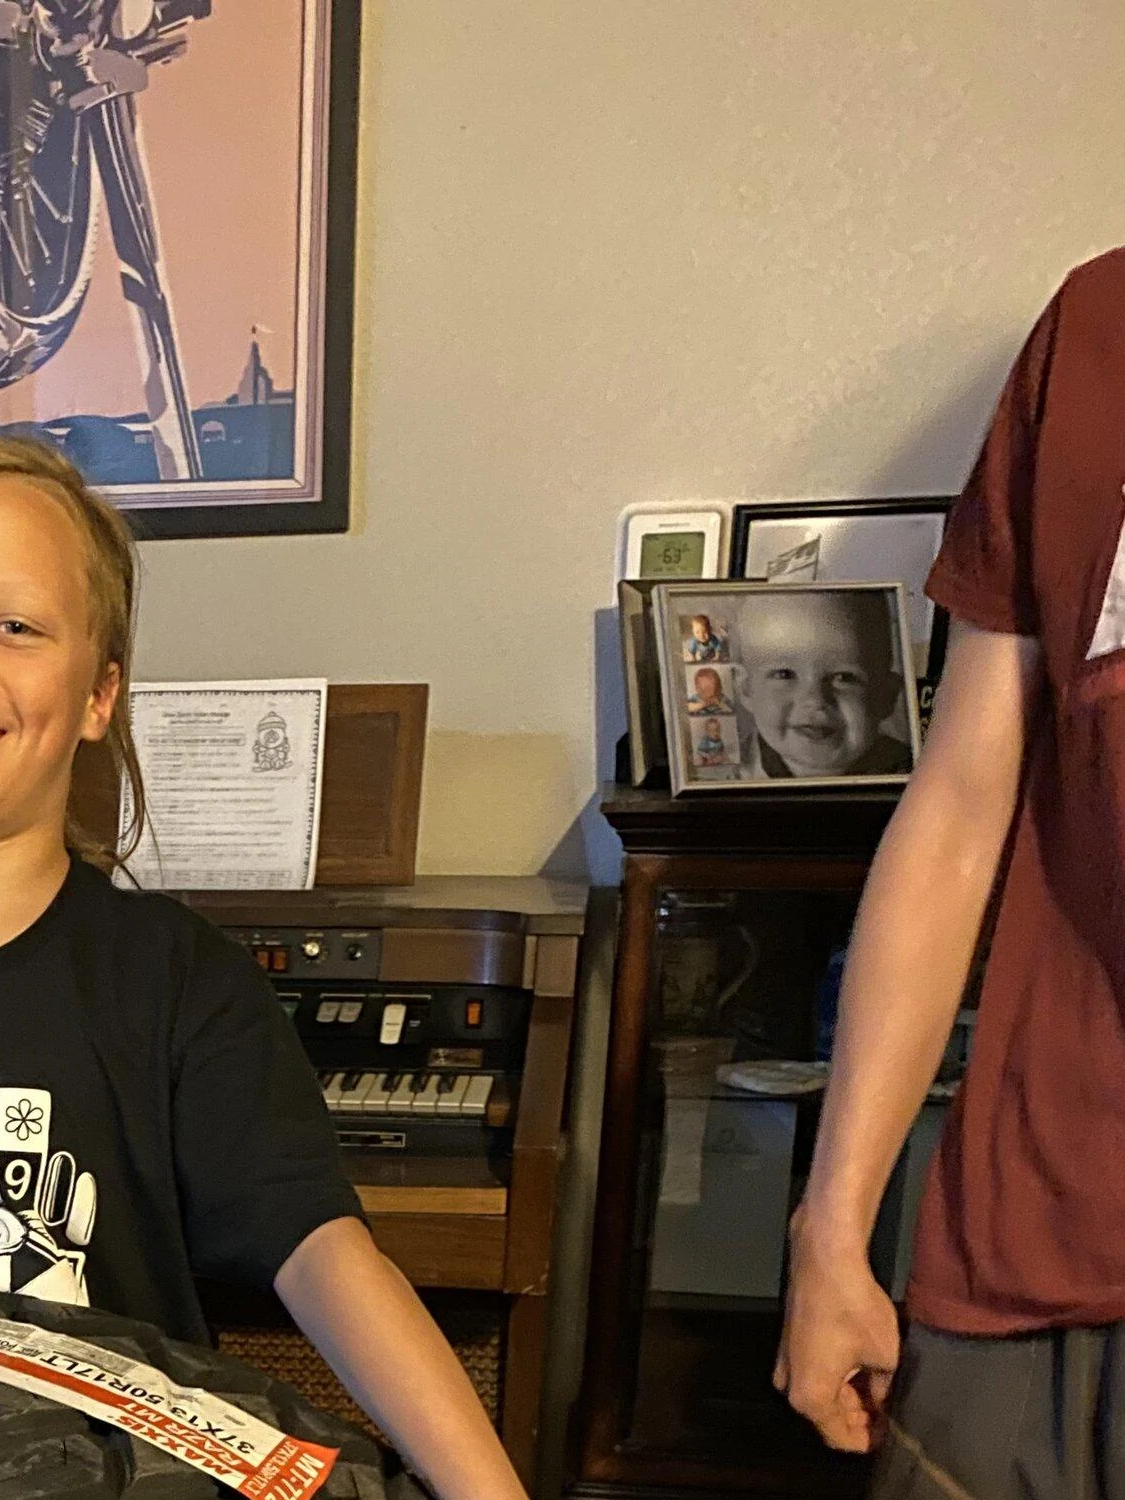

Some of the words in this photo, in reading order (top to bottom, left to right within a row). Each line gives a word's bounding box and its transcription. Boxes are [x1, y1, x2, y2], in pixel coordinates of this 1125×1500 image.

[117, 1399, 164, 1422] MT
[116, 1415, 233, 1476] MAXXIS
[167, 1421, 244, 1467] RAZR
